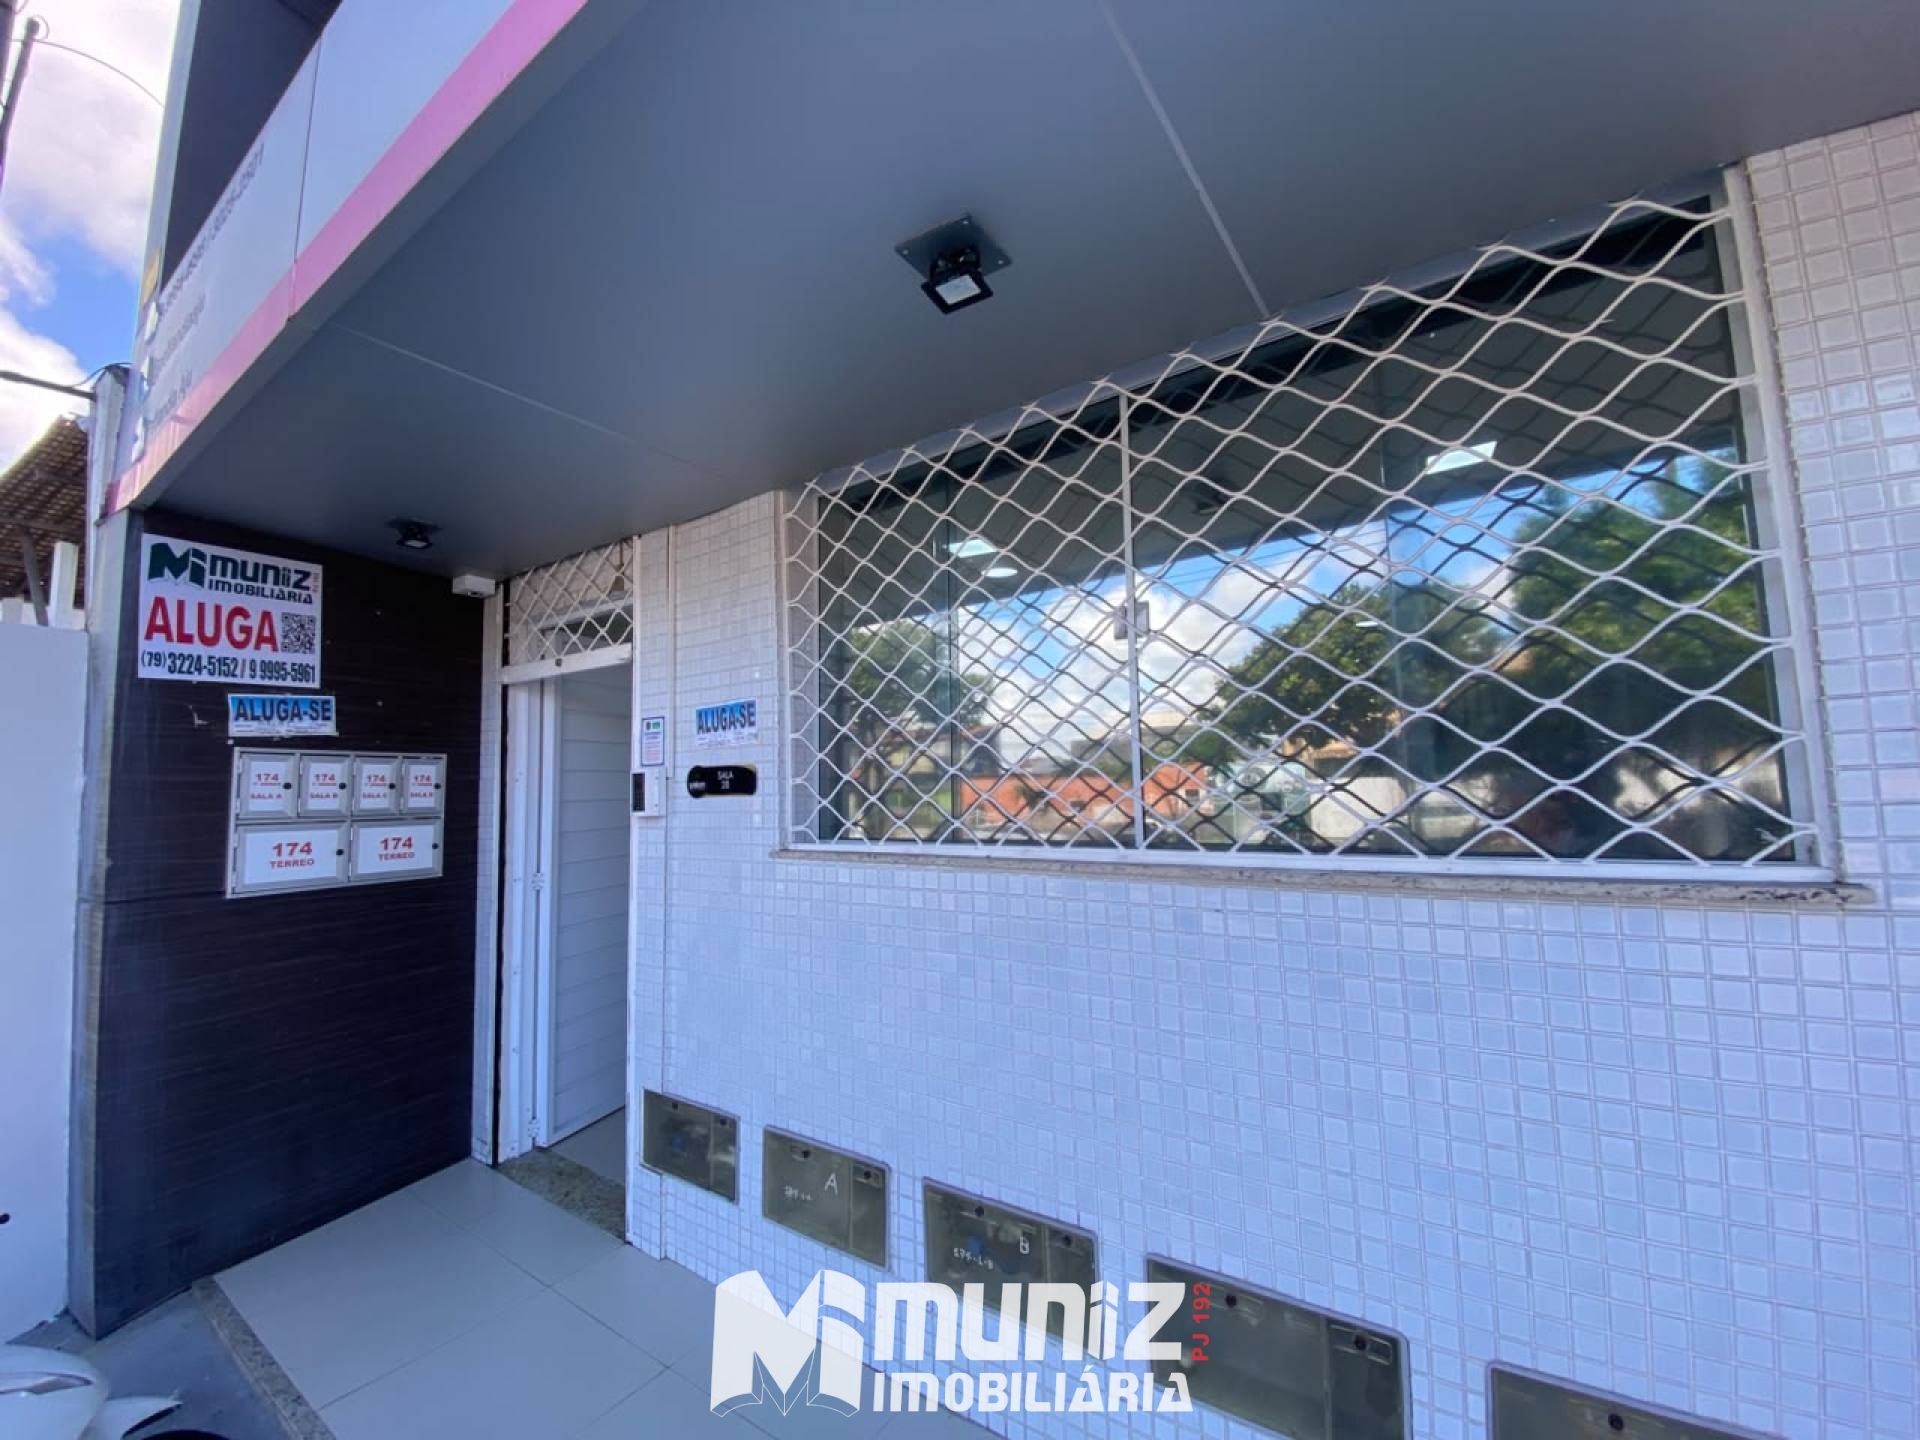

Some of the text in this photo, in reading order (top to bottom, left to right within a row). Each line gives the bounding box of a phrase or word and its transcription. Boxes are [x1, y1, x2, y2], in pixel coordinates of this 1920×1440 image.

[144, 596, 279, 652] ALUGA
[141, 650, 166, 668] (79)
[168, 652, 239, 679] 3224-5152
[249, 658, 256, 679] 9
[260, 659, 316, 683] 9995-5961
[234, 698, 332, 721] ALUGA-SE
[697, 702, 756, 735] ALUGA-SE
[256, 773, 280, 782] 174
[315, 773, 336, 782] 174
[367, 774, 385, 783] 174
[414, 774, 432, 783] 174
[272, 842, 313, 857] 174
[381, 837, 413, 850] 174
[824, 1172, 839, 1196] A
